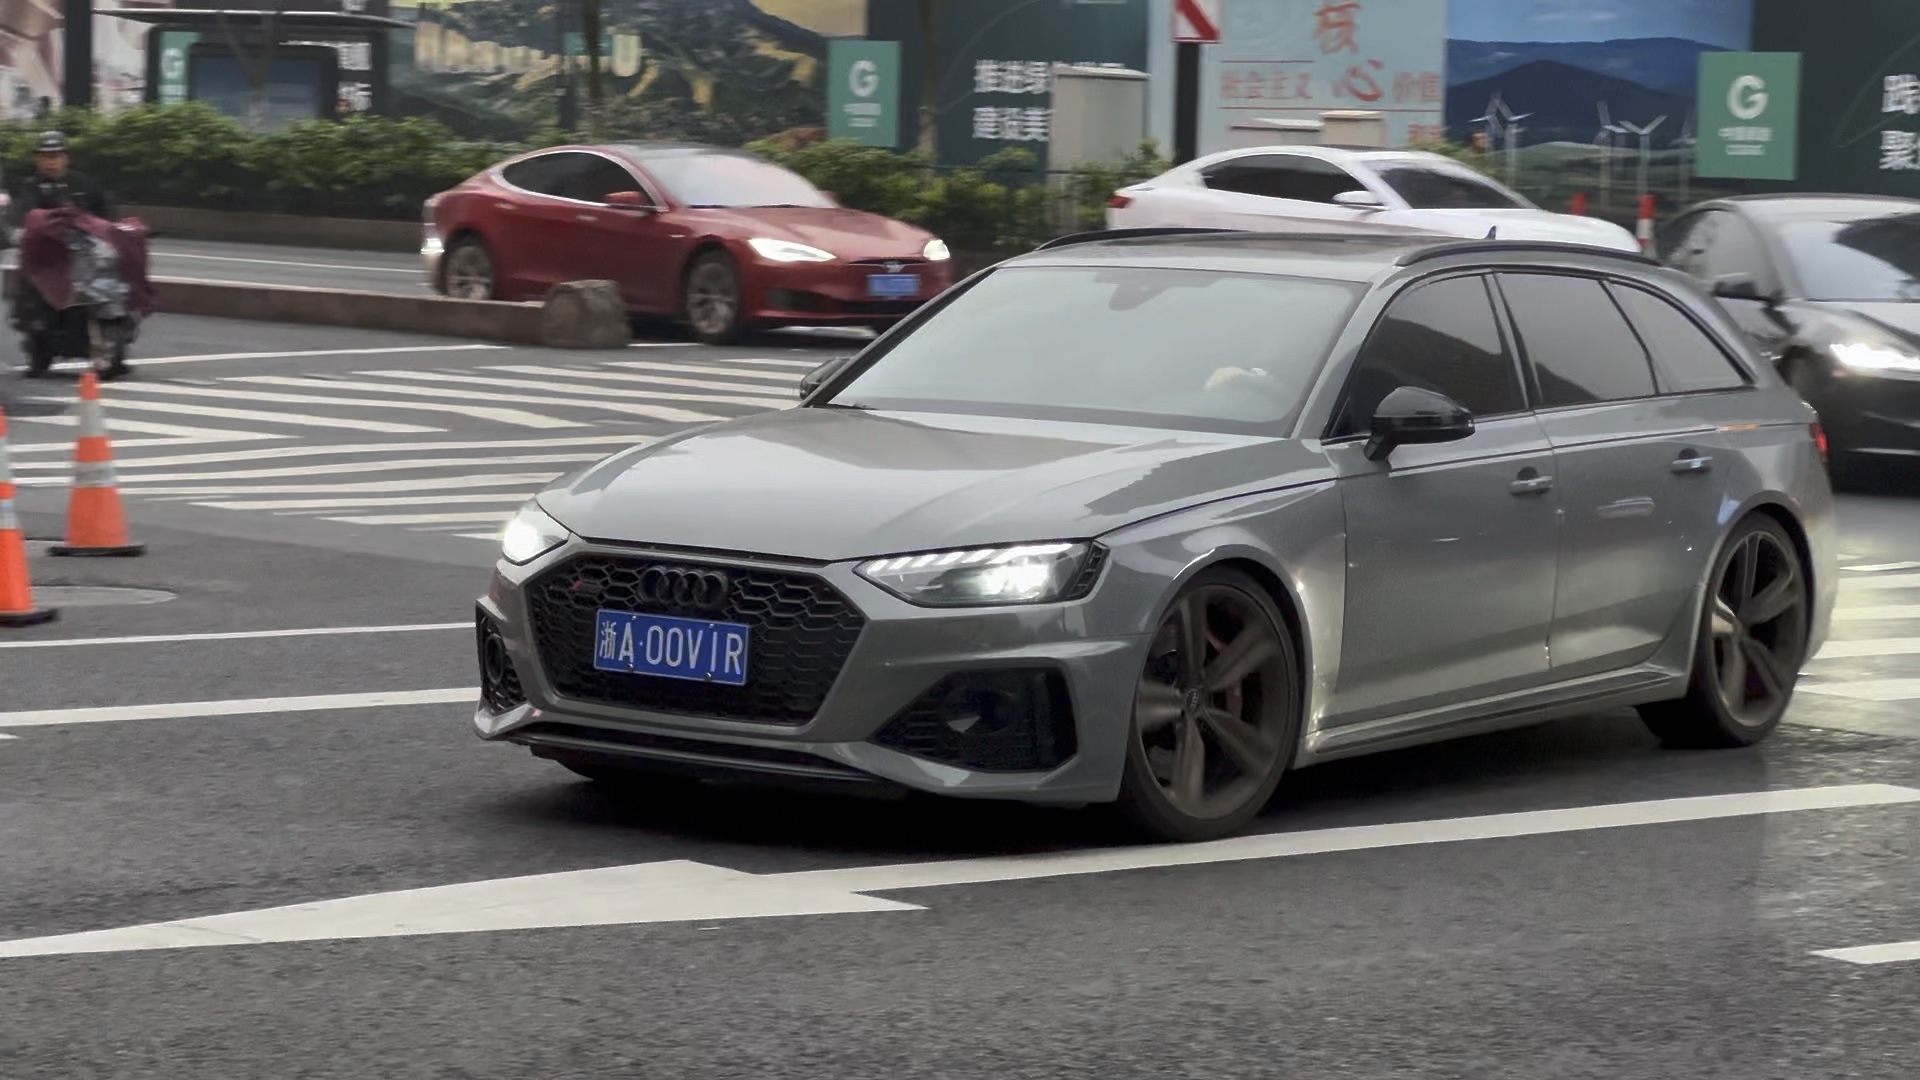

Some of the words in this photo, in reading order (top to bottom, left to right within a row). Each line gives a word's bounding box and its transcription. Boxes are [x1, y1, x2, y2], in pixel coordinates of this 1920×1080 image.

[848, 60, 879, 97] G
[1220, 70, 1313, 100] 社会主义
[1332, 59, 1384, 102] 心
[1392, 71, 1442, 103] 价值
[1726, 75, 1768, 120] G
[1879, 130, 1920, 170] 聚
